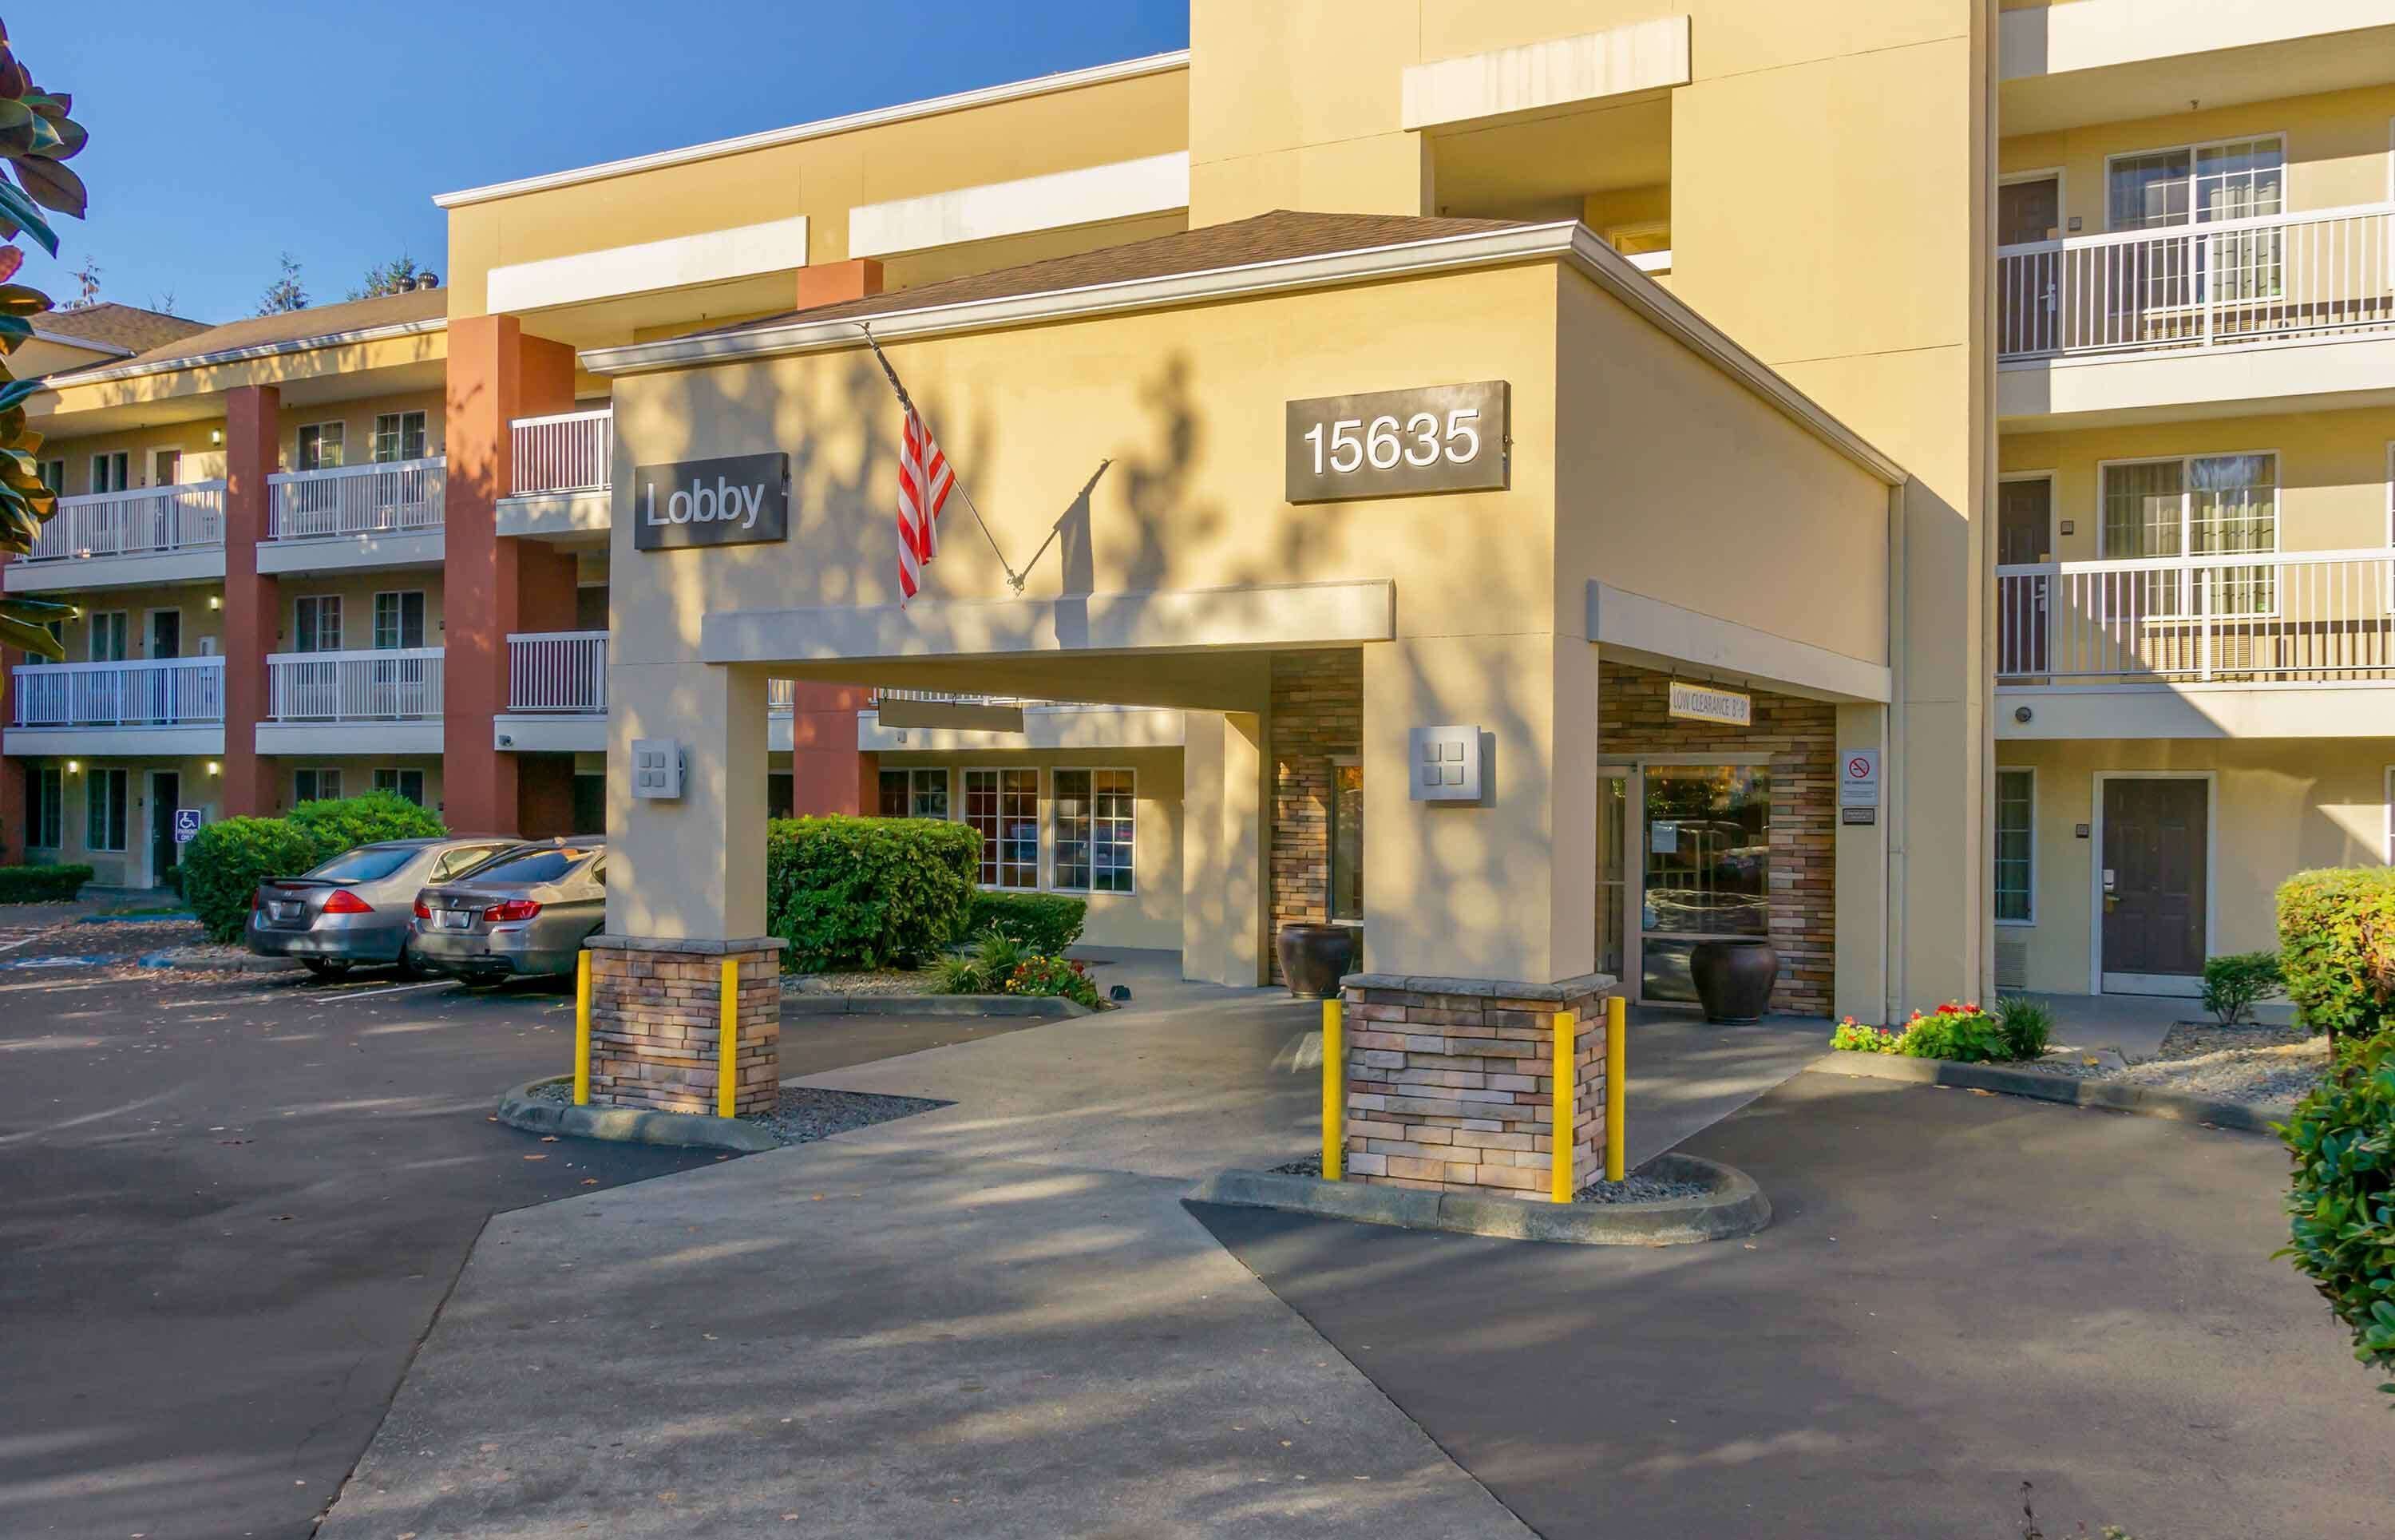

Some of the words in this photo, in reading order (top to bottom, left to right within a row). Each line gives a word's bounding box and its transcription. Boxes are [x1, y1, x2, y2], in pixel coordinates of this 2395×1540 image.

[1304, 409, 1480, 475] 15635
[647, 477, 765, 529] Lobby
[1673, 689, 1689, 710] LOW
[1692, 692, 1729, 716] CLEARANCE
